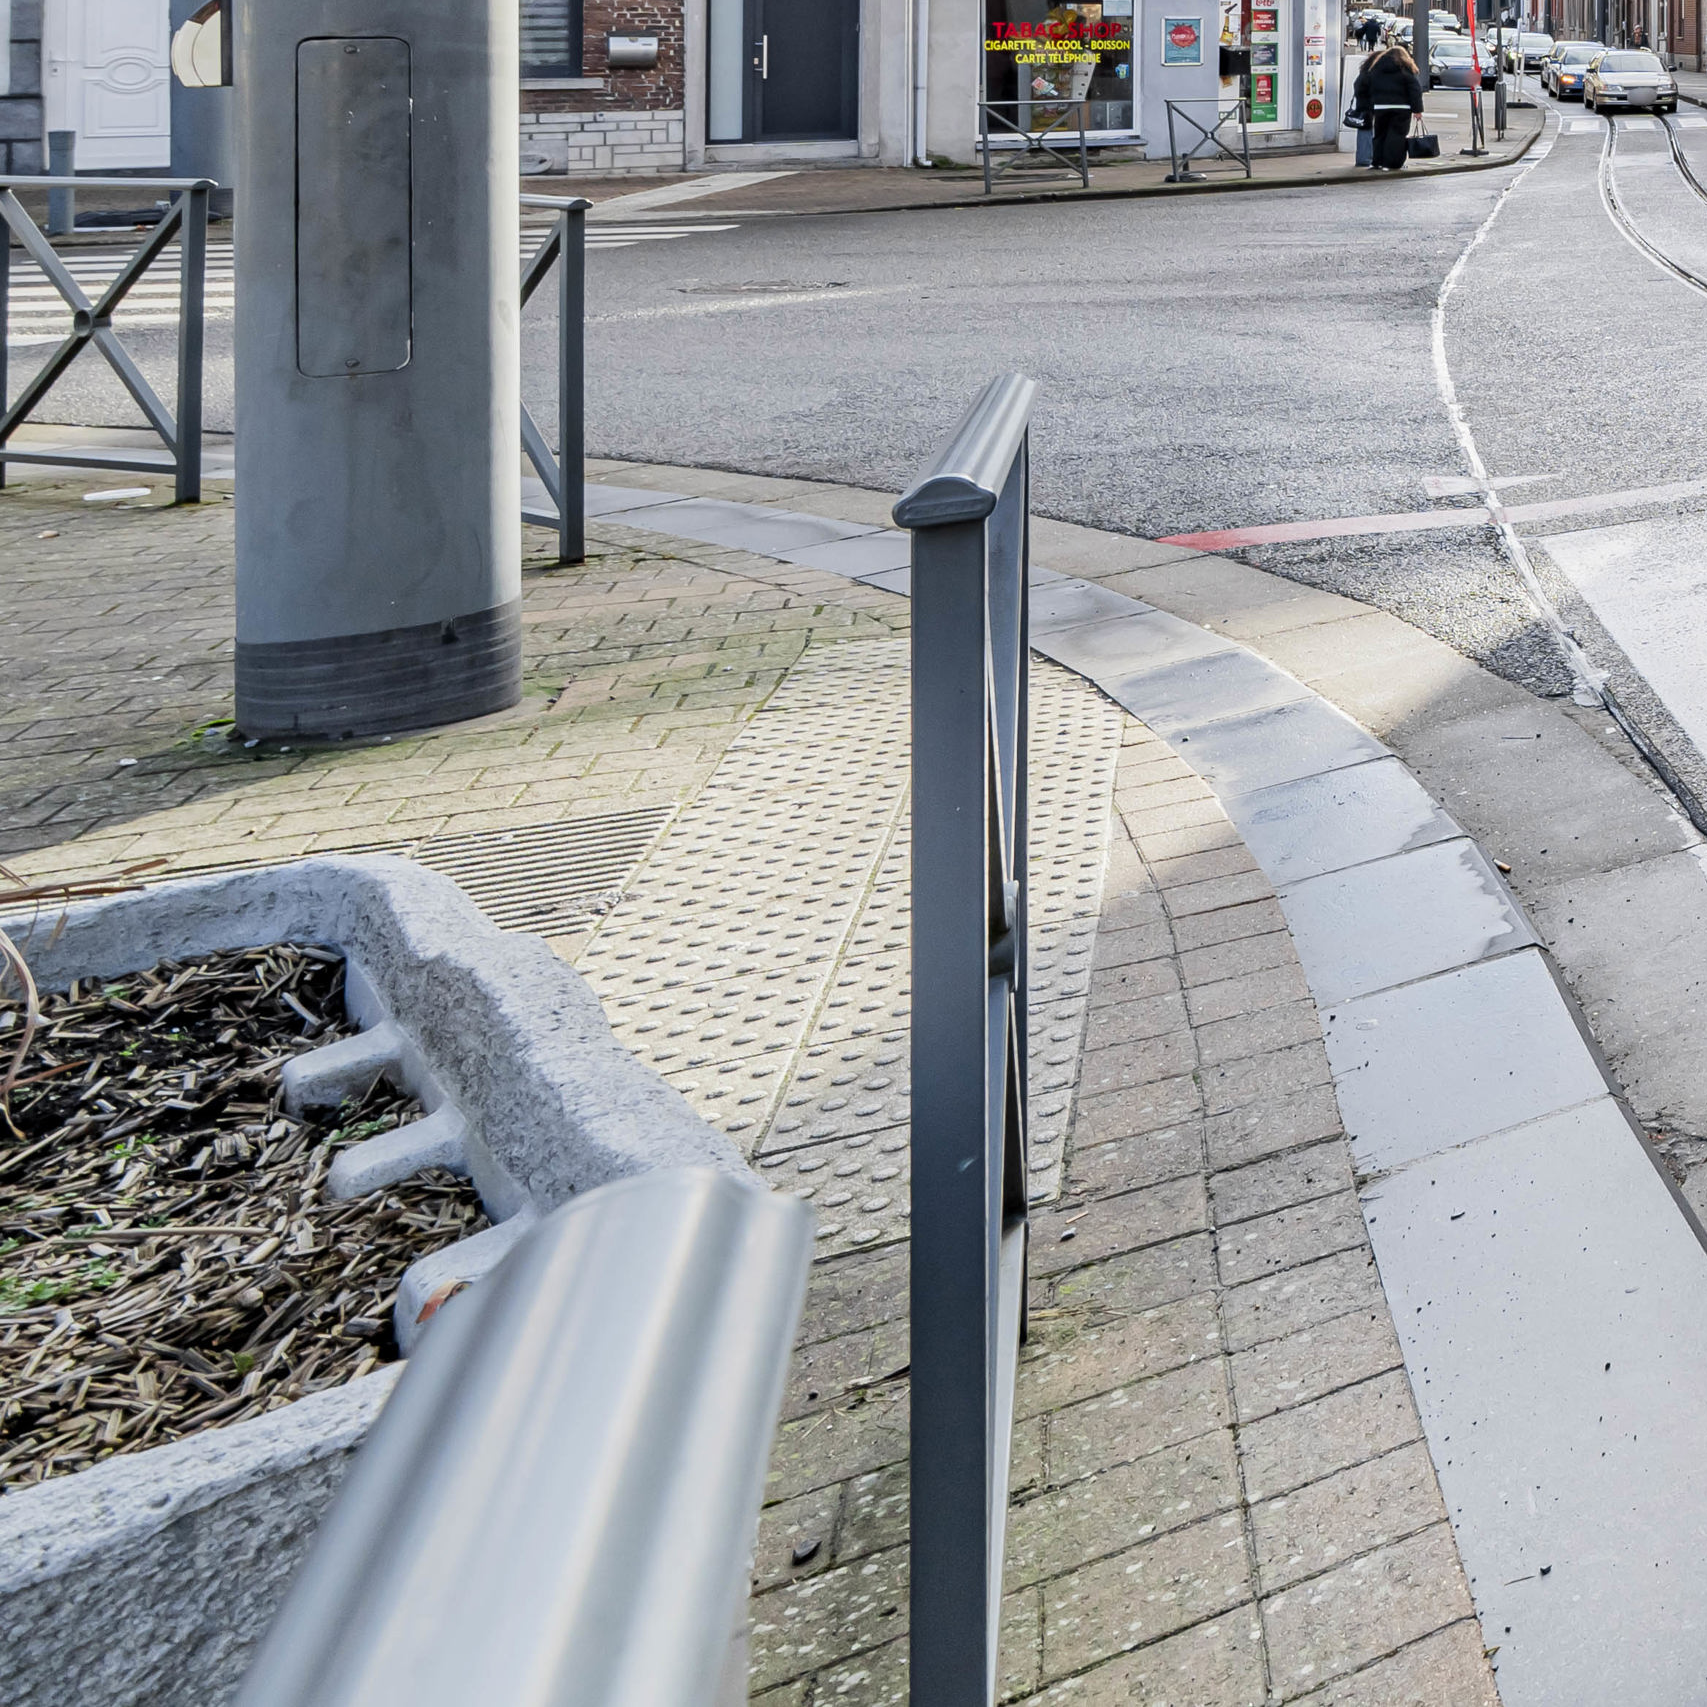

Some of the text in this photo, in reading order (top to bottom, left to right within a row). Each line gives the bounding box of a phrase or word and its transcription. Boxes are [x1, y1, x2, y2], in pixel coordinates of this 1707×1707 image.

[992, 22, 1122, 39] TABAC SHOP
[984, 40, 1036, 51] CIGARETTE
[1044, 40, 1083, 50] ALCOOL
[1091, 40, 1130, 50] BOISSON
[1015, 51, 1101, 64] CARTE TÉLÉPHONE
